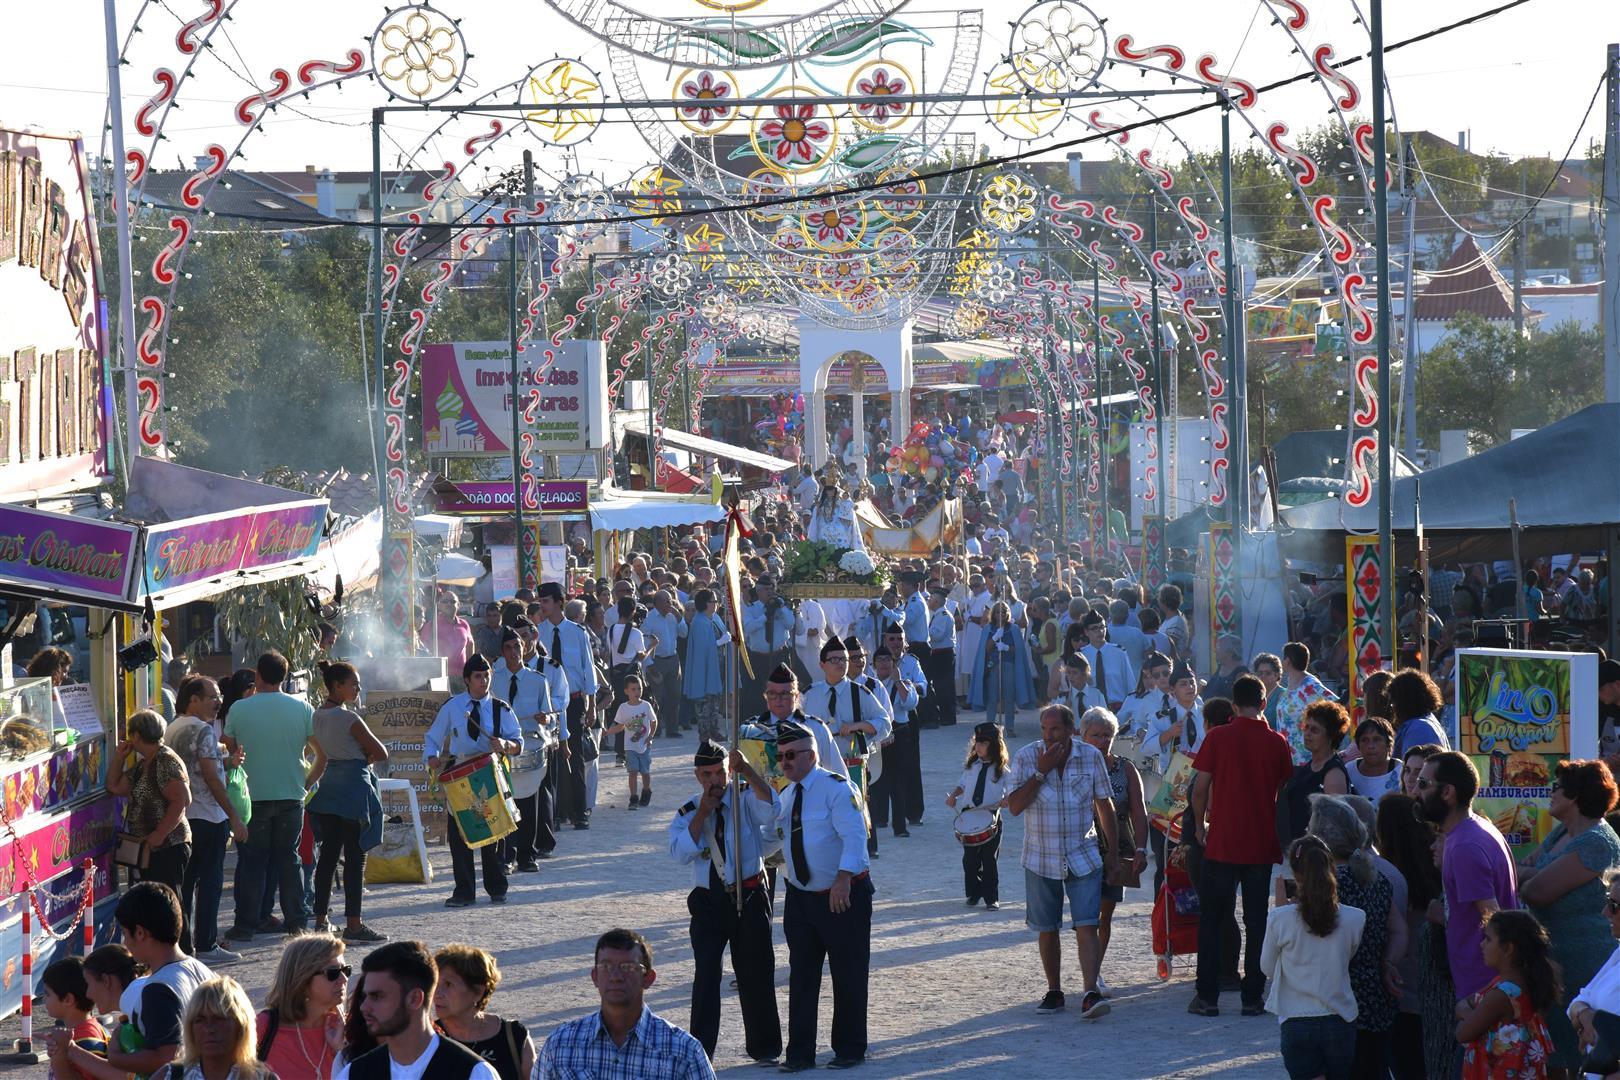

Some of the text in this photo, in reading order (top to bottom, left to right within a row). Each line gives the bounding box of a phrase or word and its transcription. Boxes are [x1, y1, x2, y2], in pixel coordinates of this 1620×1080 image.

[547, 370, 579, 386] das
[30, 530, 121, 579] Cristian
[382, 711, 434, 728] ALVES
